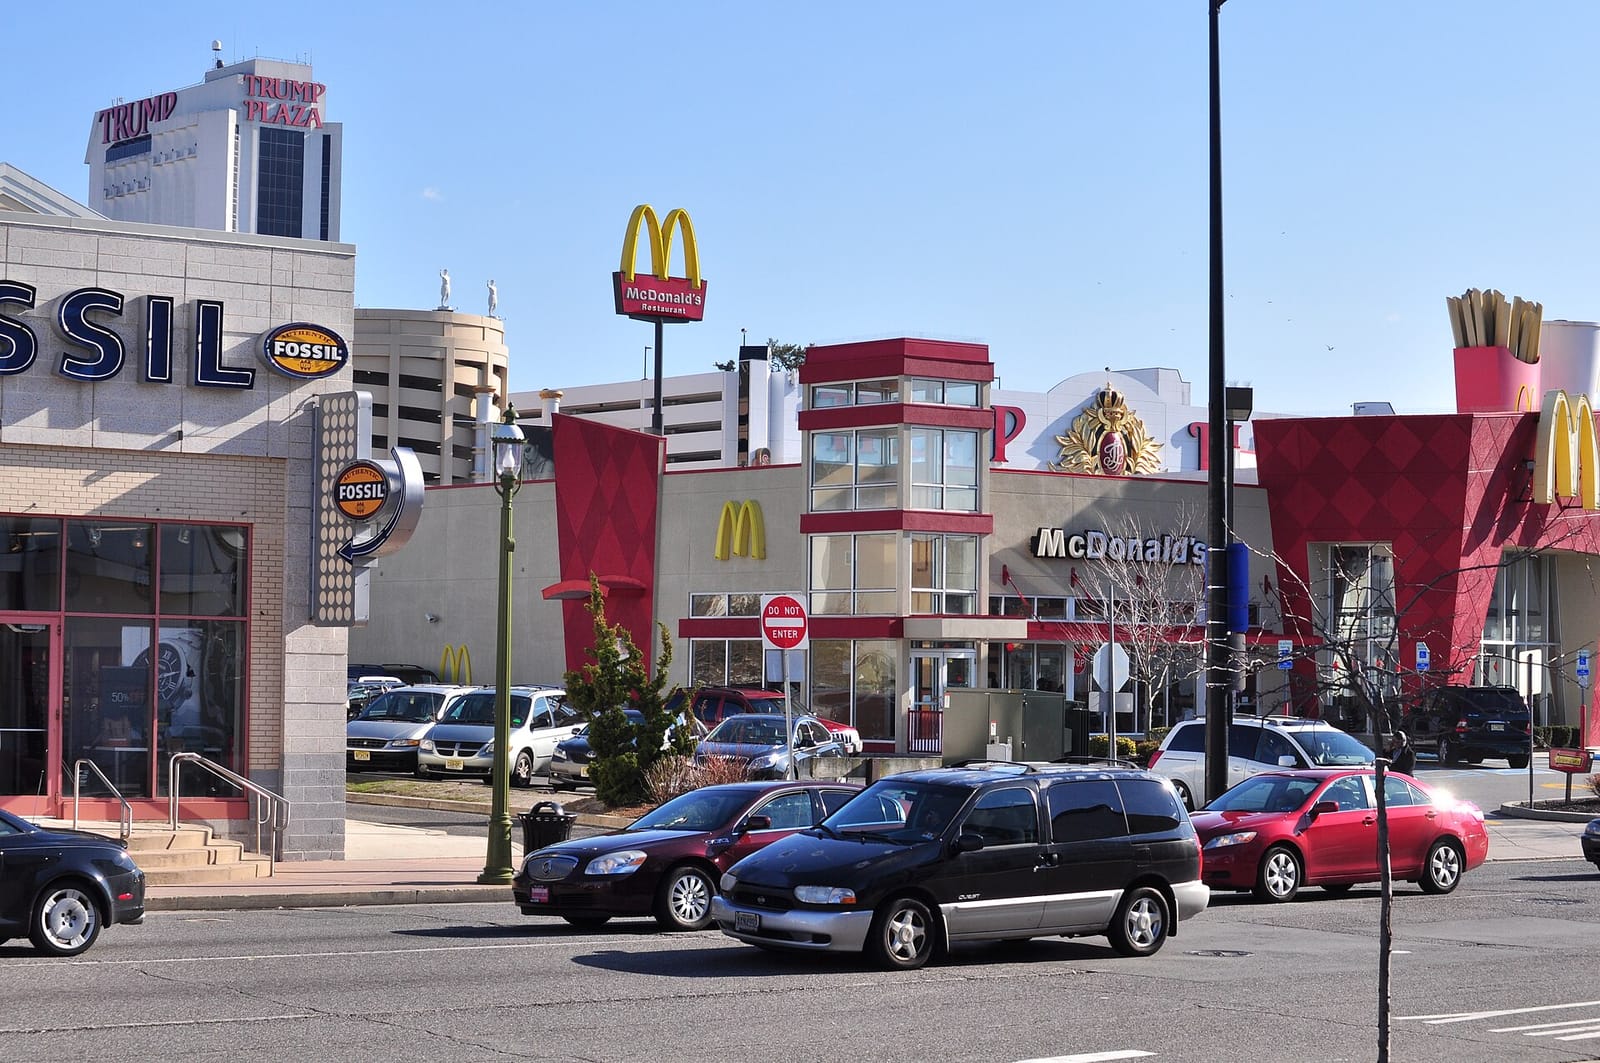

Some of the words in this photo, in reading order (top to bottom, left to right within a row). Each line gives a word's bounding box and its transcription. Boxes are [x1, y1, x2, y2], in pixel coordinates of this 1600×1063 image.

[243, 73, 327, 104] TRUMP
[99, 91, 177, 144] TRUMP
[243, 100, 323, 128] PLAZA
[626, 286, 702, 306] McDonald's
[641, 302, 686, 314] Restaurant
[281, 330, 333, 345] AUTHENTIC
[273, 340, 343, 361] FOSSIL
[342, 468, 380, 482] AUTHENTIC
[339, 483, 384, 500] FOSSIL
[1036, 527, 1207, 566] McDonald's
[768, 606, 780, 615] DO
[784, 606, 800, 615] NOT
[772, 629, 798, 639] ENTER
